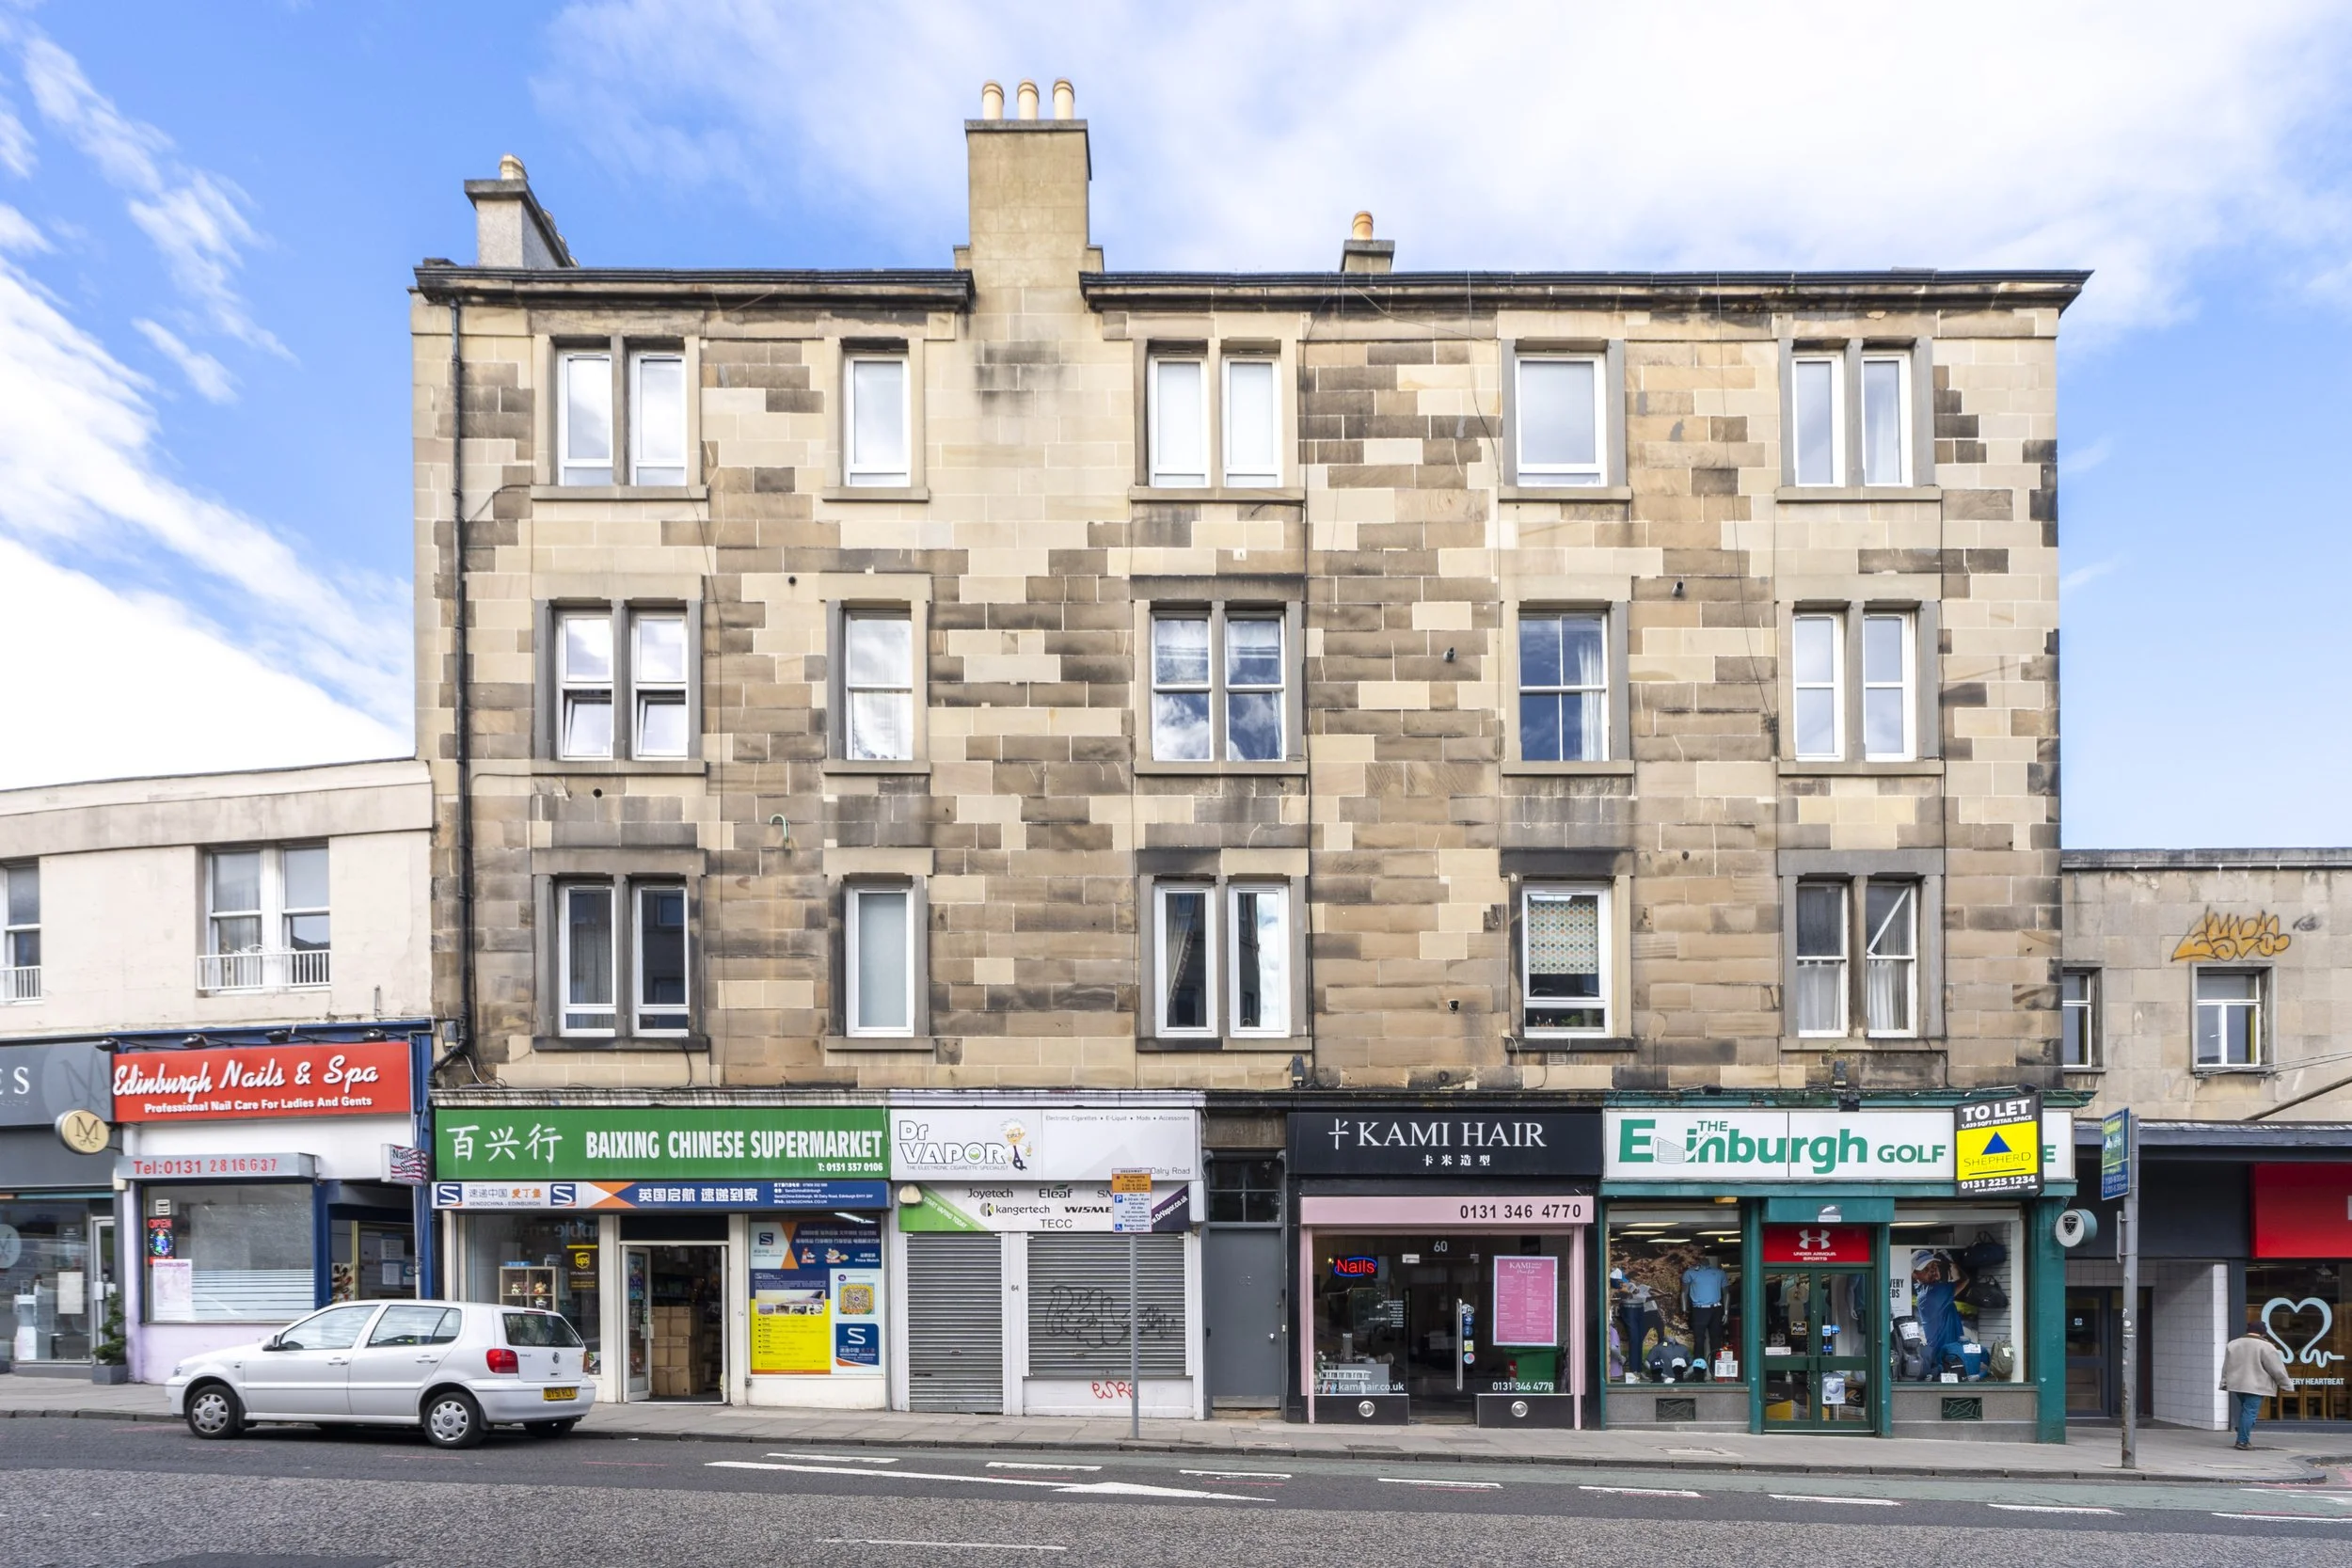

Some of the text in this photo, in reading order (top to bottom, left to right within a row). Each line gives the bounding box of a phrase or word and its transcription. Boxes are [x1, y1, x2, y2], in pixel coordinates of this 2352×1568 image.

[112, 1054, 379, 1103] Edinburgh Nails & Spa
[144, 1096, 373, 1114] Professional Nail Care For Ladies And Gents
[1963, 1100, 2030, 1122] TO LET
[1697, 1120, 1728, 1132] THE
[1993, 1117, 2012, 1126] RETAIL
[2013, 1115, 2032, 1123] SPACE
[899, 1120, 929, 1140] Dr
[1357, 1121, 1548, 1147] KAMI HAIR
[446, 1122, 563, 1164] 百兴行
[585, 1130, 882, 1159] BAIXING CHINESE SUPERMARKET
[899, 1142, 1007, 1164] VAPOR
[1422, 1154, 1491, 1166] 卡米造型
[1877, 1144, 1947, 1164] GOLF
[1963, 1151, 2032, 1168] SHEPHERD
[826, 1163, 846, 1172] 0131
[847, 1163, 862, 1172] 337
[863, 1163, 883, 1172] 0106
[1151, 1166, 1190, 1176] Dalry Road
[1961, 1175, 2036, 1190] 0131 225 1234
[638, 1187, 758, 1202] 英国启航 速递到家
[967, 1188, 1073, 1199] Joyetech Eleaf
[995, 1202, 1051, 1215] kangertech
[1460, 1204, 1581, 1219] 0131 346 4770
[1040, 1219, 1073, 1228] TECC
[1434, 1241, 1448, 1253] 60
[1336, 1259, 1375, 1274] Nails
[1492, 1382, 1554, 1391] 0131 346 4770
[2306, 1377, 2344, 1386] HEARTBEAT
